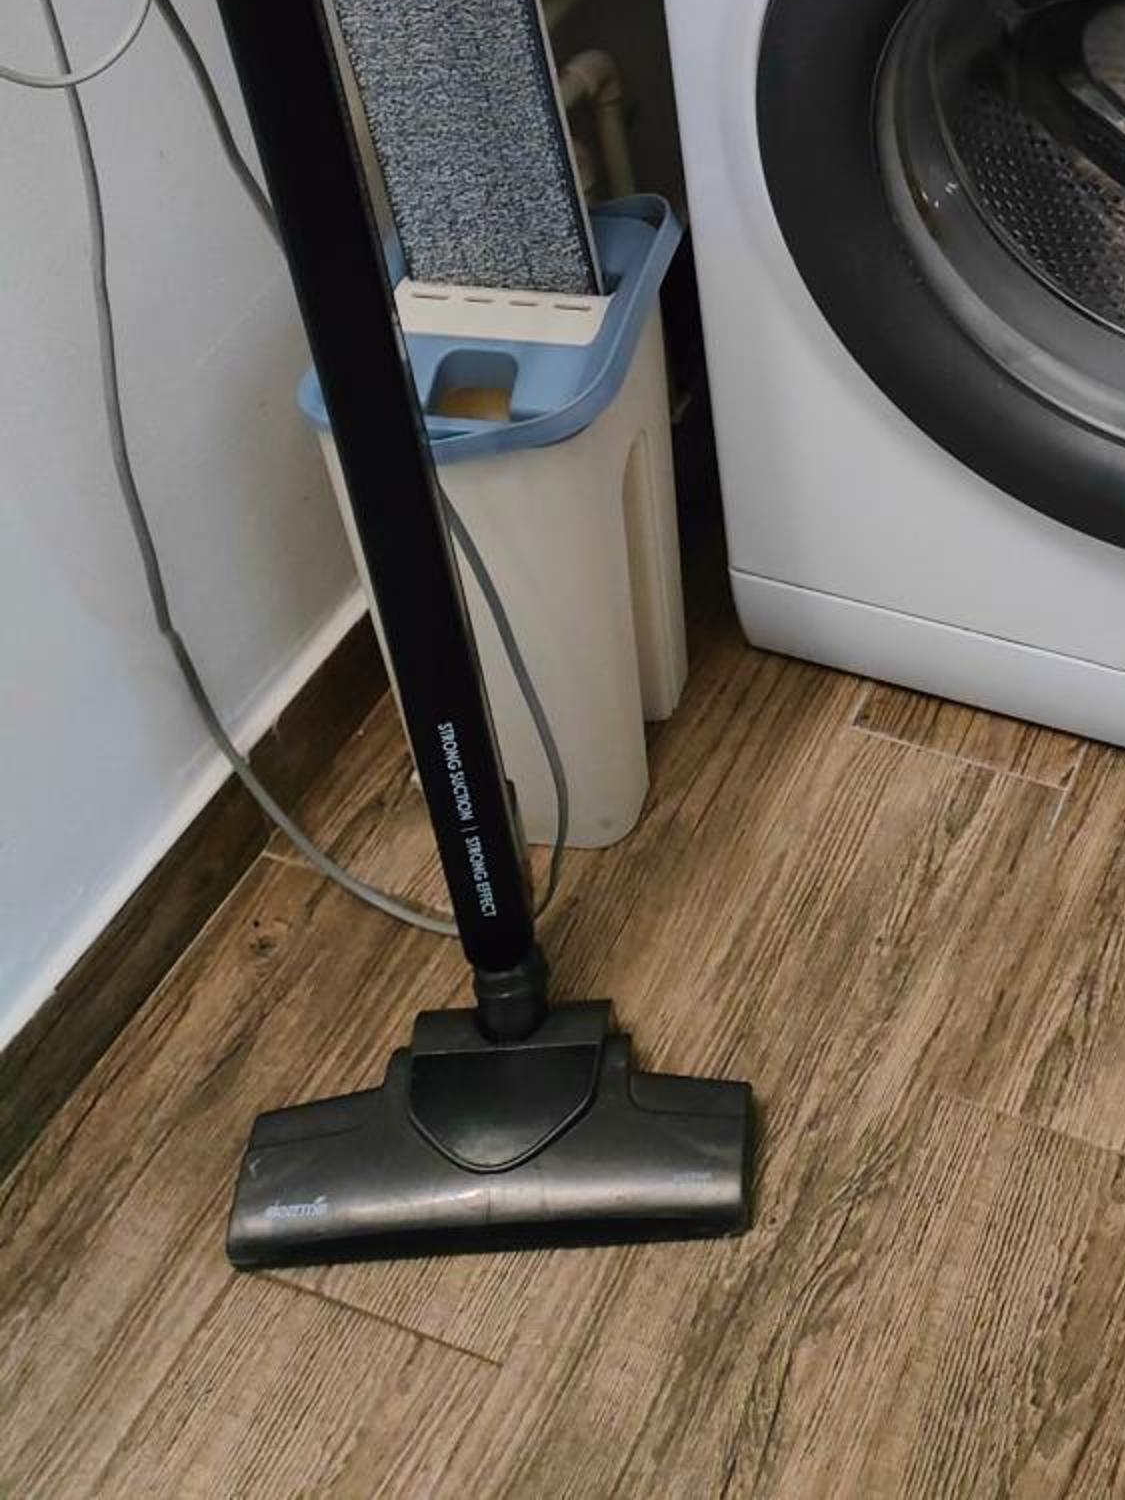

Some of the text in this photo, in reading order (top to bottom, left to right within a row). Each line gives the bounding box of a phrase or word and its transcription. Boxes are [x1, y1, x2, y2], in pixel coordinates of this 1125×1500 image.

[438, 722, 475, 821] STRONG SUCTION
[465, 836, 497, 917] STRONG EFFECT
